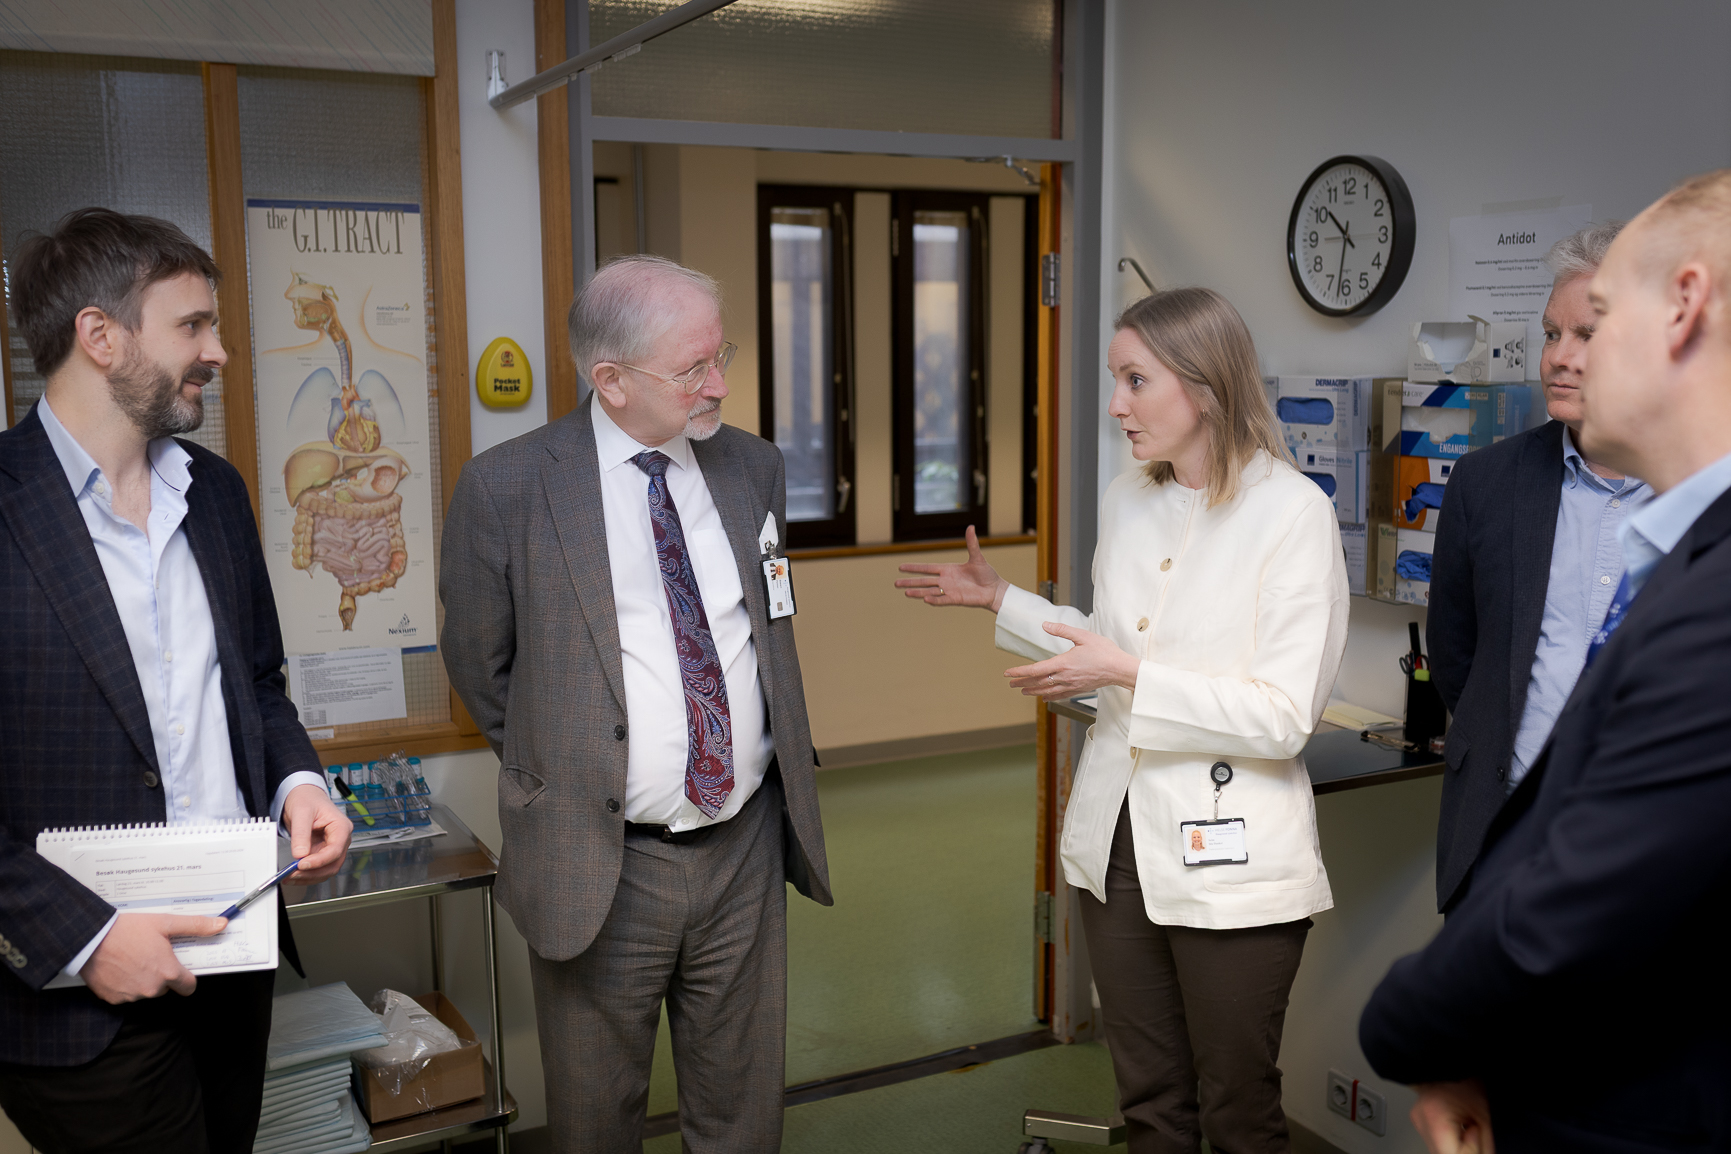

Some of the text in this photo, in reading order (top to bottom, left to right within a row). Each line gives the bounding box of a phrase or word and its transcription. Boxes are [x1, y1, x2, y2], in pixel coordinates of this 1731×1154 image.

[1328, 186, 1337, 203] 11
[1343, 177, 1356, 195] 12
[1364, 182, 1369, 199] 1
[1315, 206, 1328, 223] 10
[1374, 199, 1384, 217] 2
[267, 206, 287, 230] the
[1309, 231, 1318, 248] 9
[1378, 225, 1388, 243] 3
[1497, 231, 1536, 246] Antidot
[1313, 255, 1323, 272] 8
[1371, 252, 1382, 270] 4
[1326, 274, 1335, 291] 7
[1341, 279, 1351, 296] 6
[1359, 272, 1368, 290] 5
[494, 384, 520, 392] Mask
[1319, 455, 1334, 464] Gloves
[388, 627, 416, 635] Nexium
[116, 867, 149, 875] Haugesund
